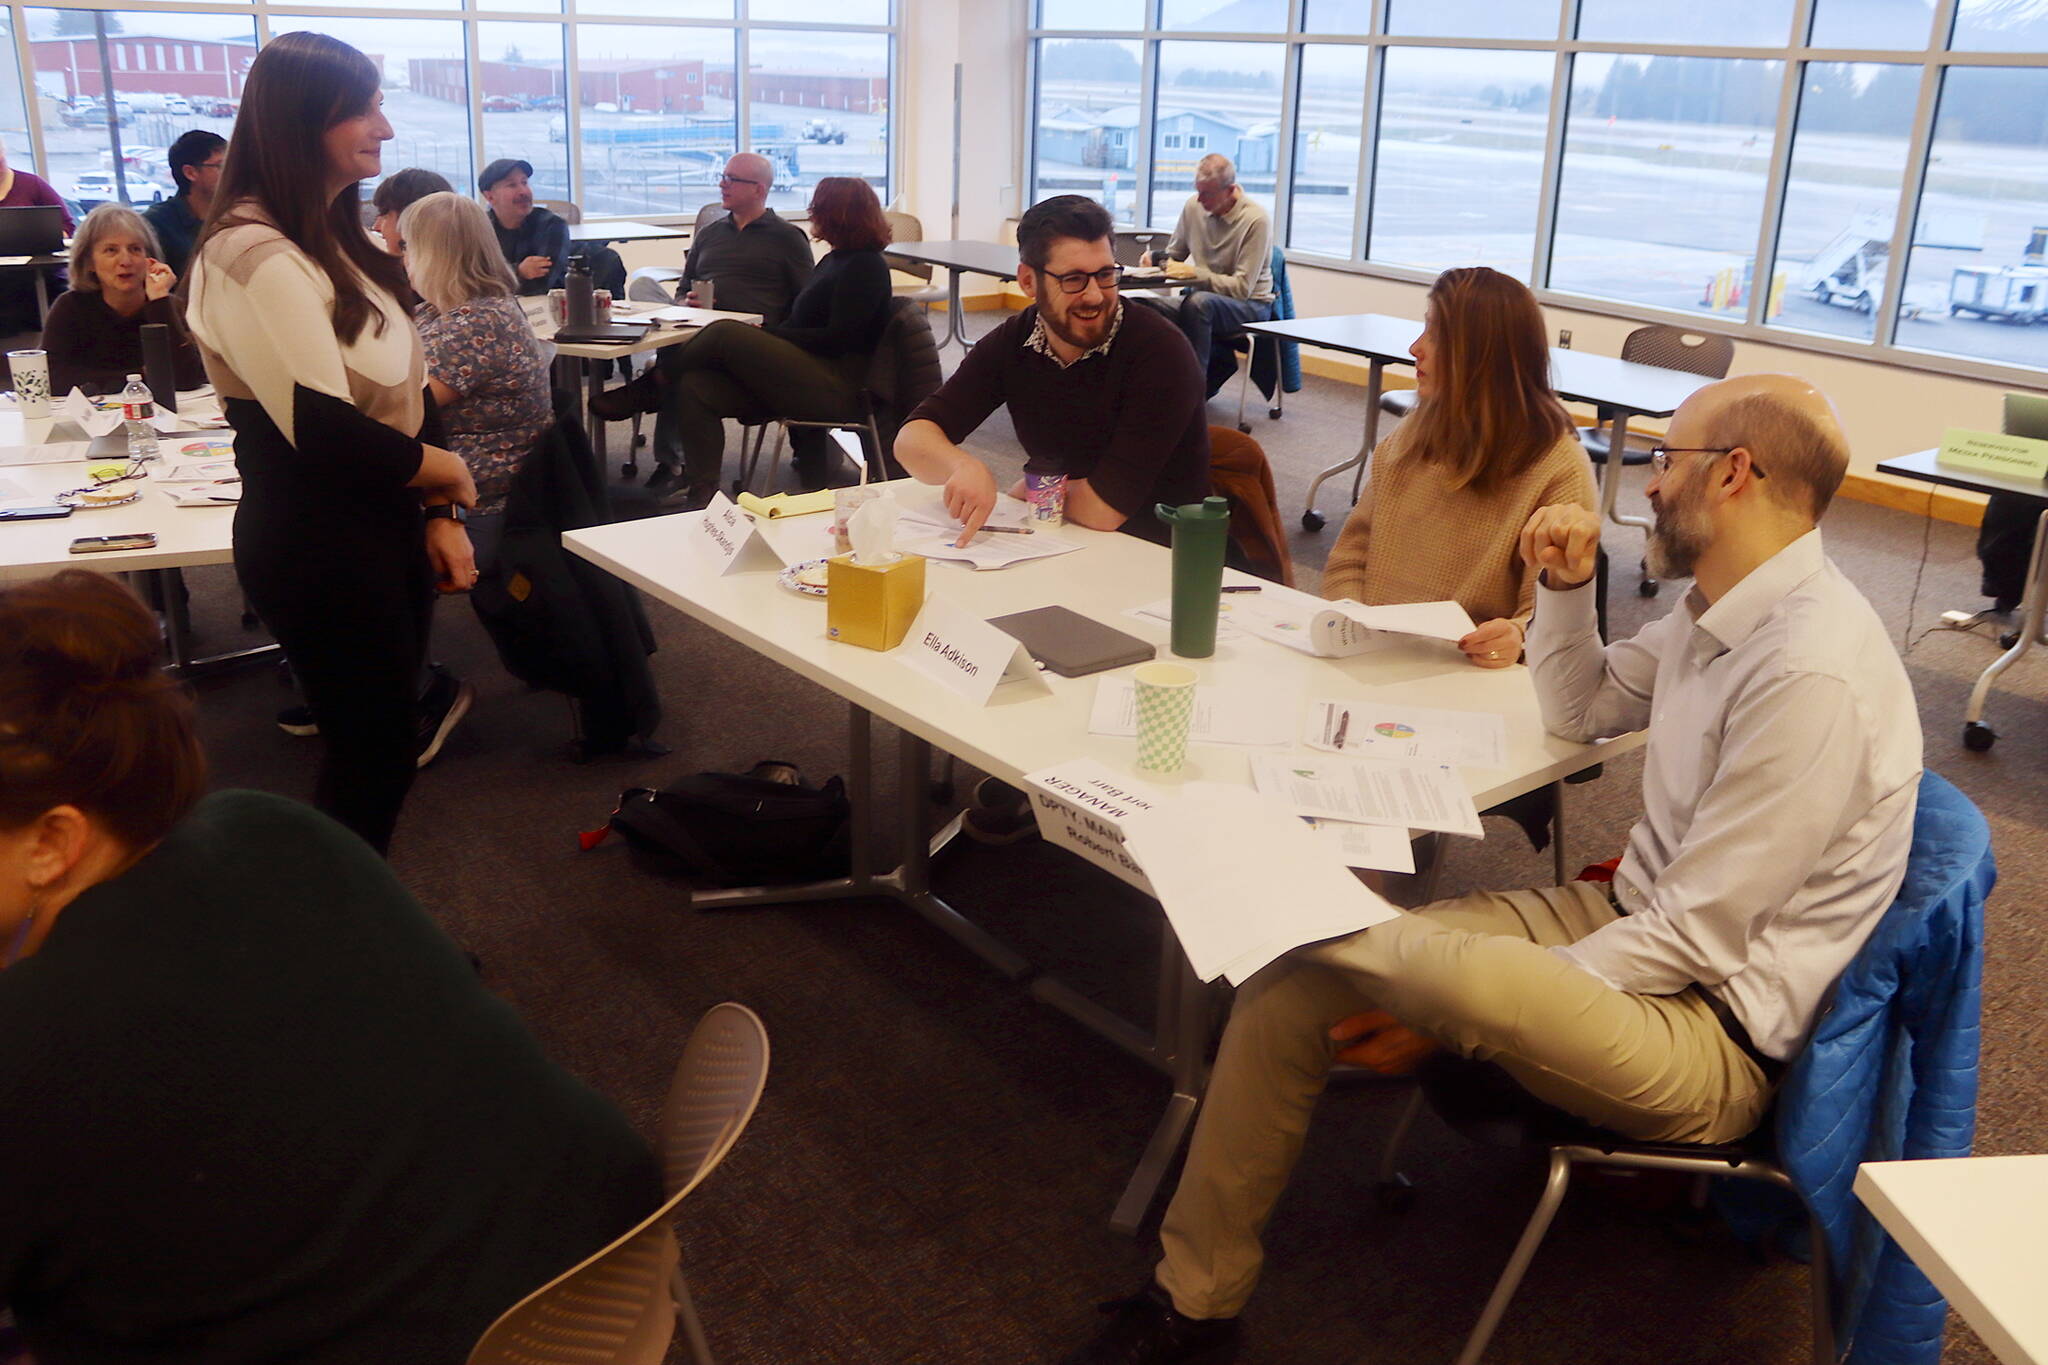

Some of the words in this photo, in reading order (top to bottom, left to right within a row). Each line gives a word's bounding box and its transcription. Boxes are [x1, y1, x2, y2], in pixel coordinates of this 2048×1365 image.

[923, 632, 942, 652] Ella
[940, 644, 979, 677] Adkison
[1044, 776, 1128, 817] MANAGER
[1066, 826, 1117, 862] Robert
